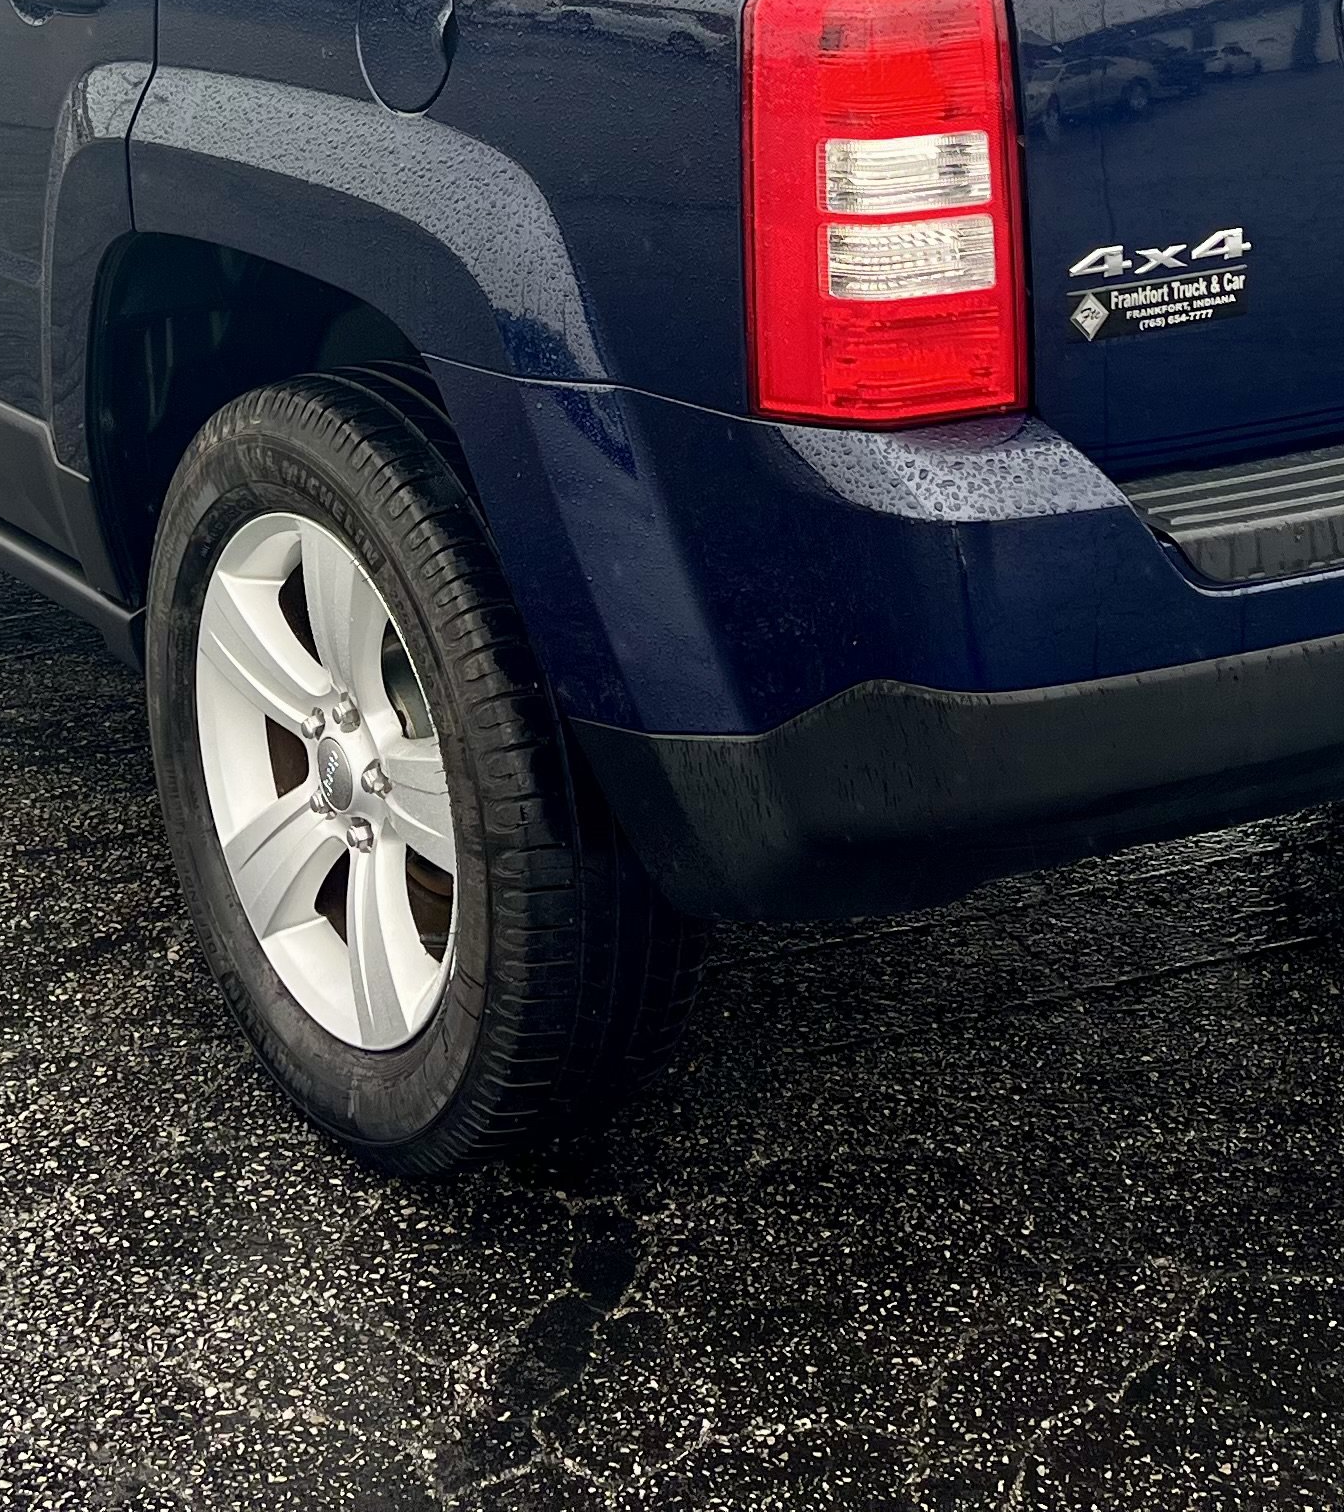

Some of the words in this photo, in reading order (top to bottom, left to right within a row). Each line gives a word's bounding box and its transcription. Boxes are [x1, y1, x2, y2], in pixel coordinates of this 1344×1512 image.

[1069, 227, 1252, 278] 4x4
[1110, 285, 1170, 310] Frankfort
[1171, 277, 1208, 300] Truck
[1210, 274, 1221, 294] &
[1223, 272, 1246, 292] Car
[1125, 301, 1191, 320] FRANKFORT,
[1192, 294, 1236, 309] INDIANA
[1138, 316, 1166, 331] (765)
[1167, 309, 1214, 325] 654-7777
[281, 460, 380, 565] MICHELIN
